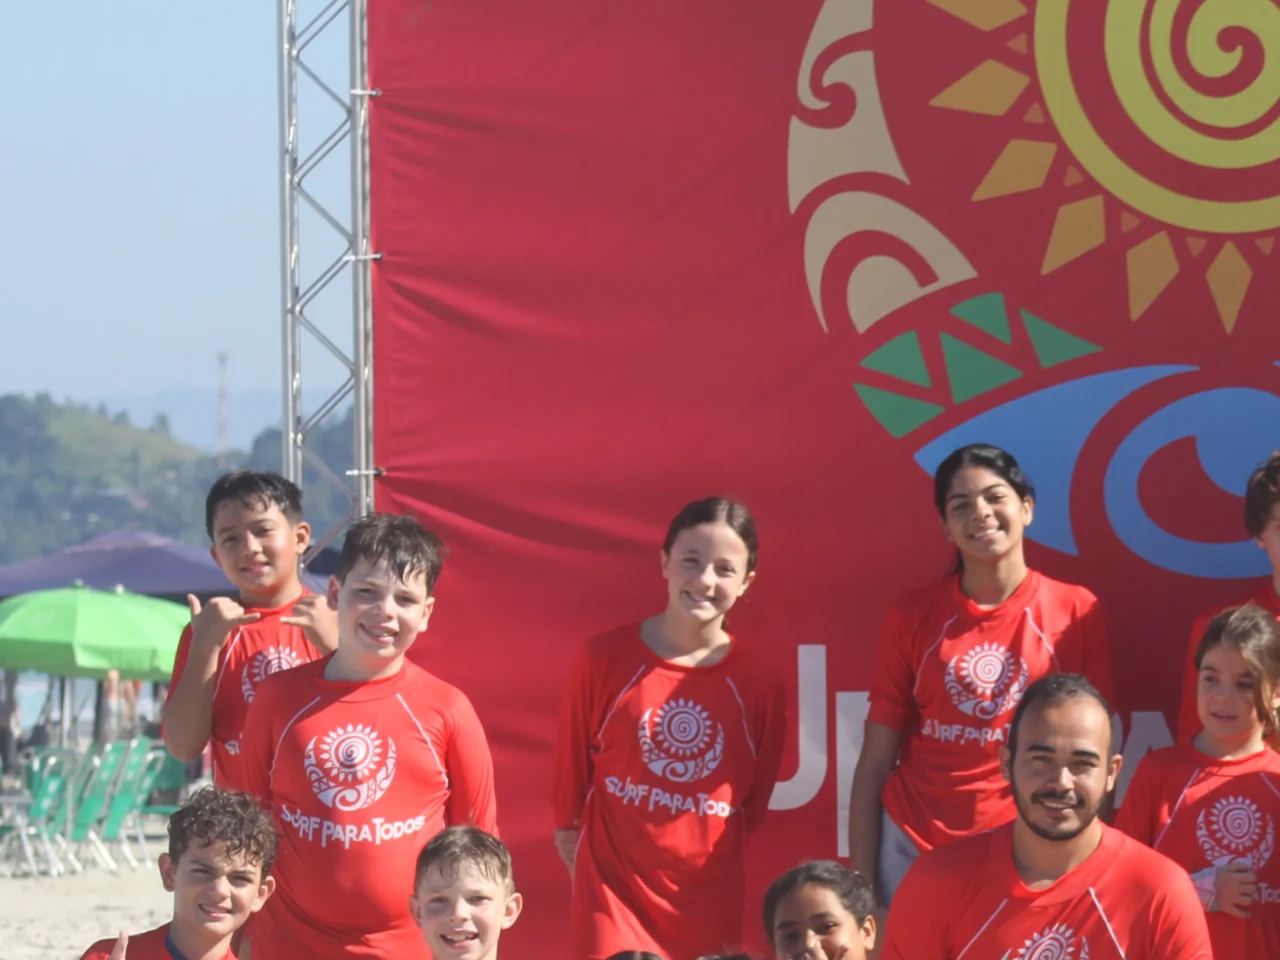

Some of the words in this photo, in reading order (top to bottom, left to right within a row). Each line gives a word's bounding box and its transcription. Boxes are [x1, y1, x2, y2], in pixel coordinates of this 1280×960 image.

[605, 776, 649, 807] SURF
[649, 787, 696, 815] PARA
[697, 792, 732, 817] TOD
[281, 804, 321, 842] SURF
[321, 820, 373, 850] PARA
[372, 815, 426, 846] TODOS
